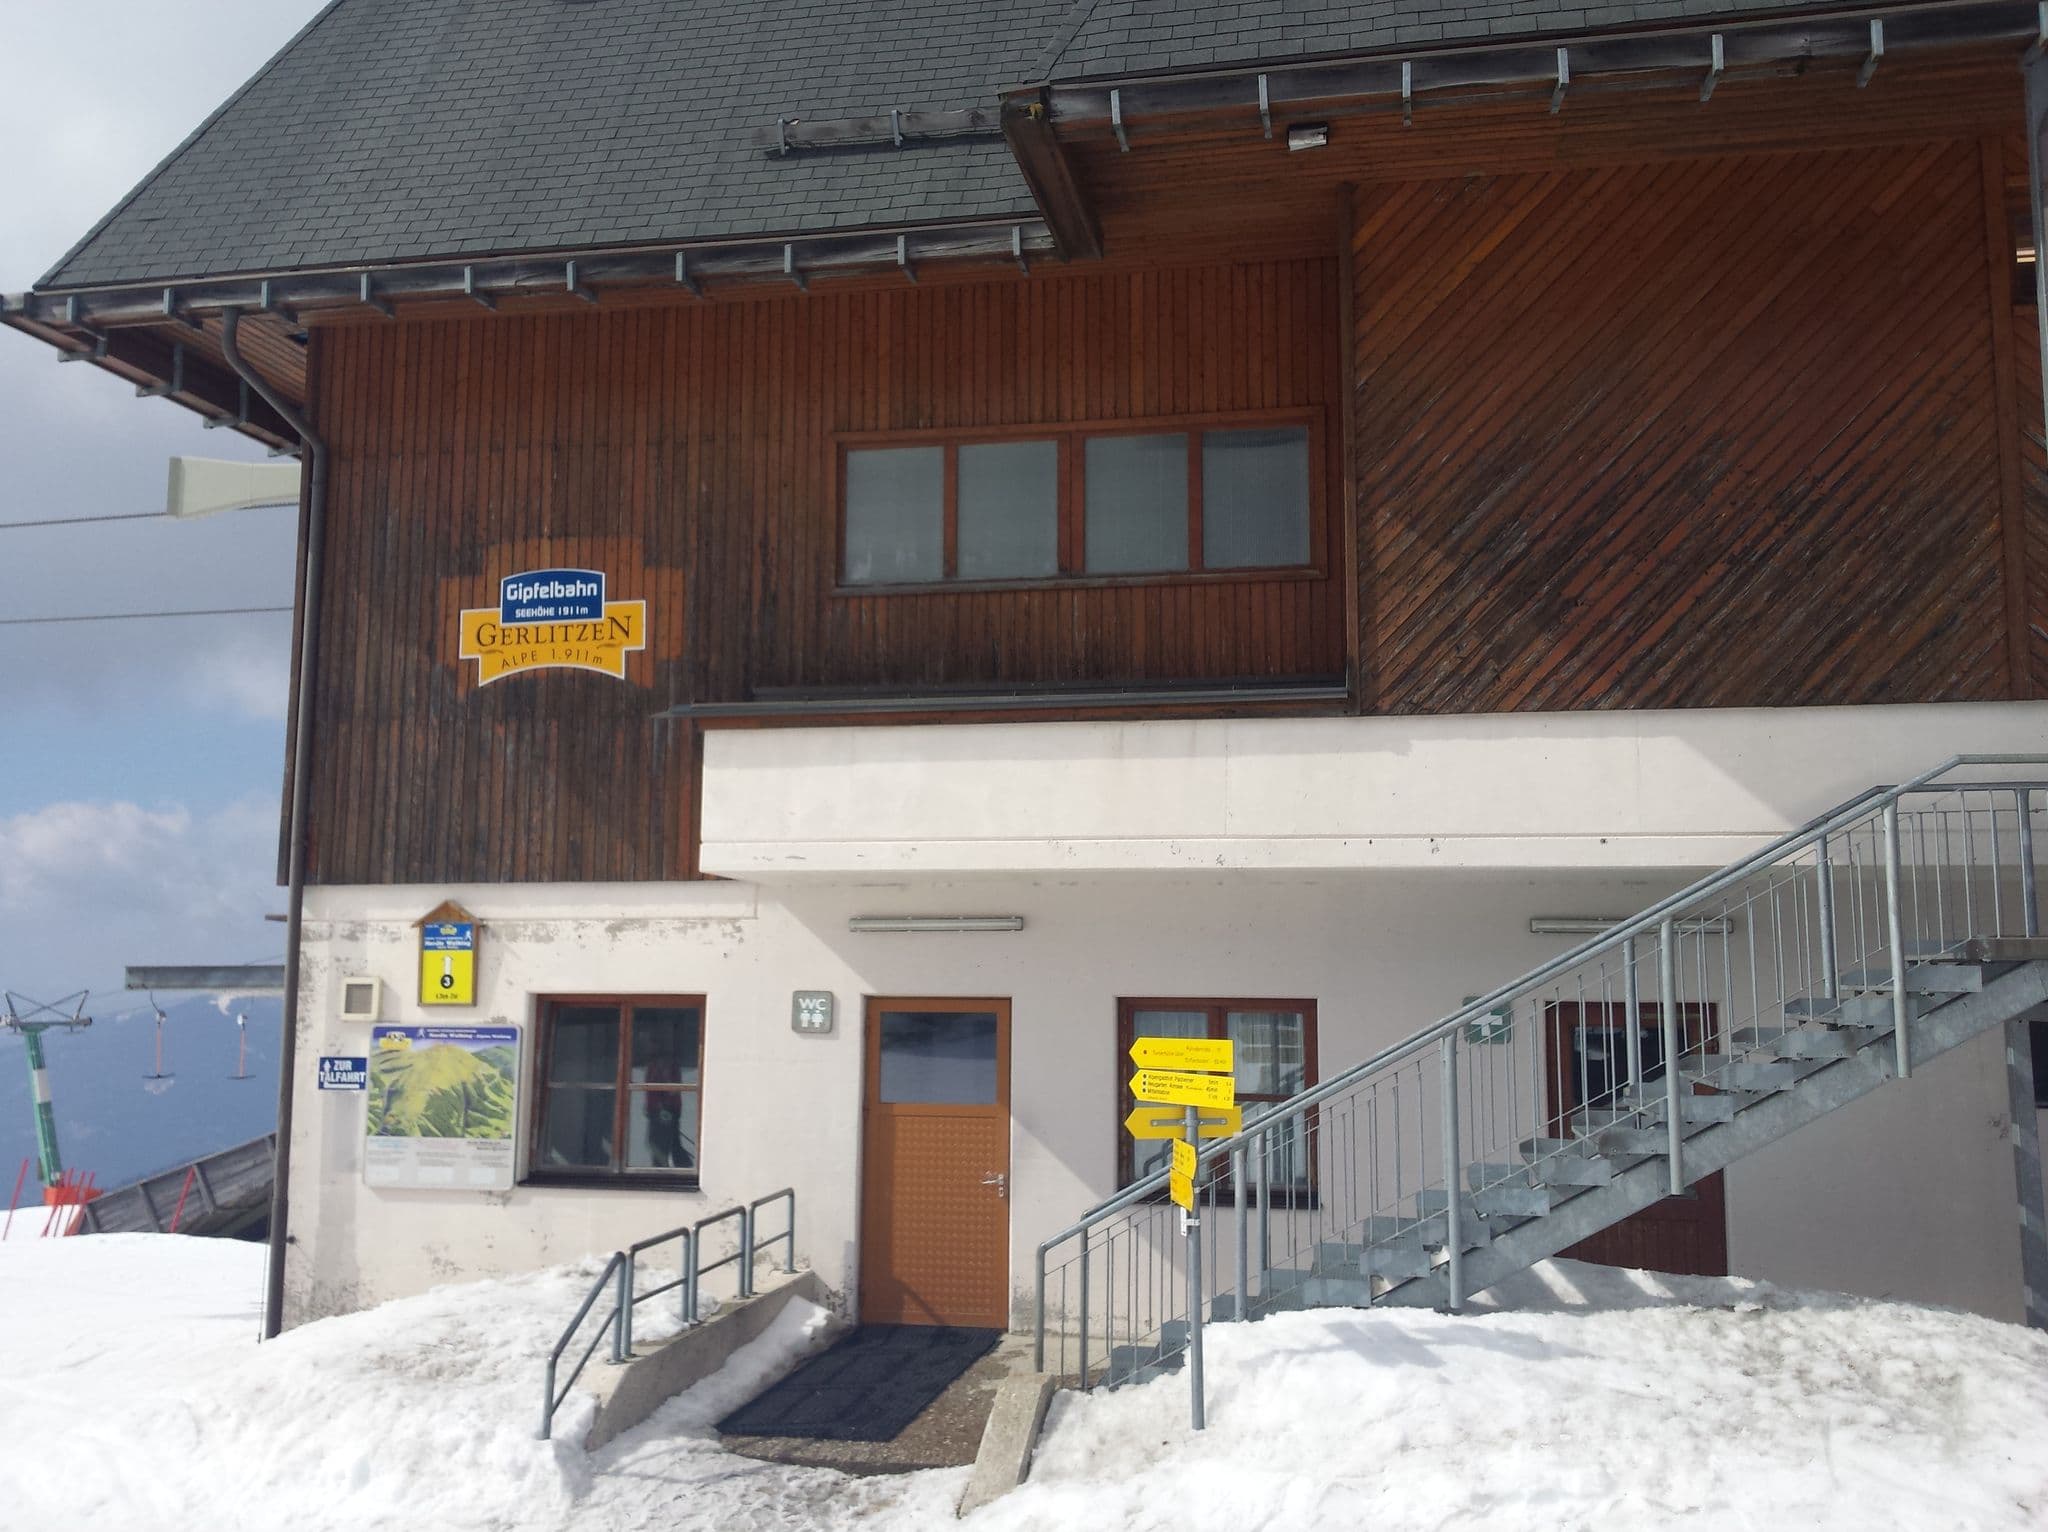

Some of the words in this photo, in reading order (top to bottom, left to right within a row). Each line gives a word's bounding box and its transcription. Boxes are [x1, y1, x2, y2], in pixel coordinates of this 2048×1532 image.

[506, 580, 598, 604] Gipfelbahn
[515, 606, 555, 619] SEEHÖHE
[476, 615, 632, 647] GERLITZEN
[501, 650, 538, 669] ALPE
[443, 976, 451, 987] 3
[798, 998, 826, 1010] WC
[333, 1060, 353, 1071] ZUR
[319, 1071, 366, 1083] TALFAHRT
